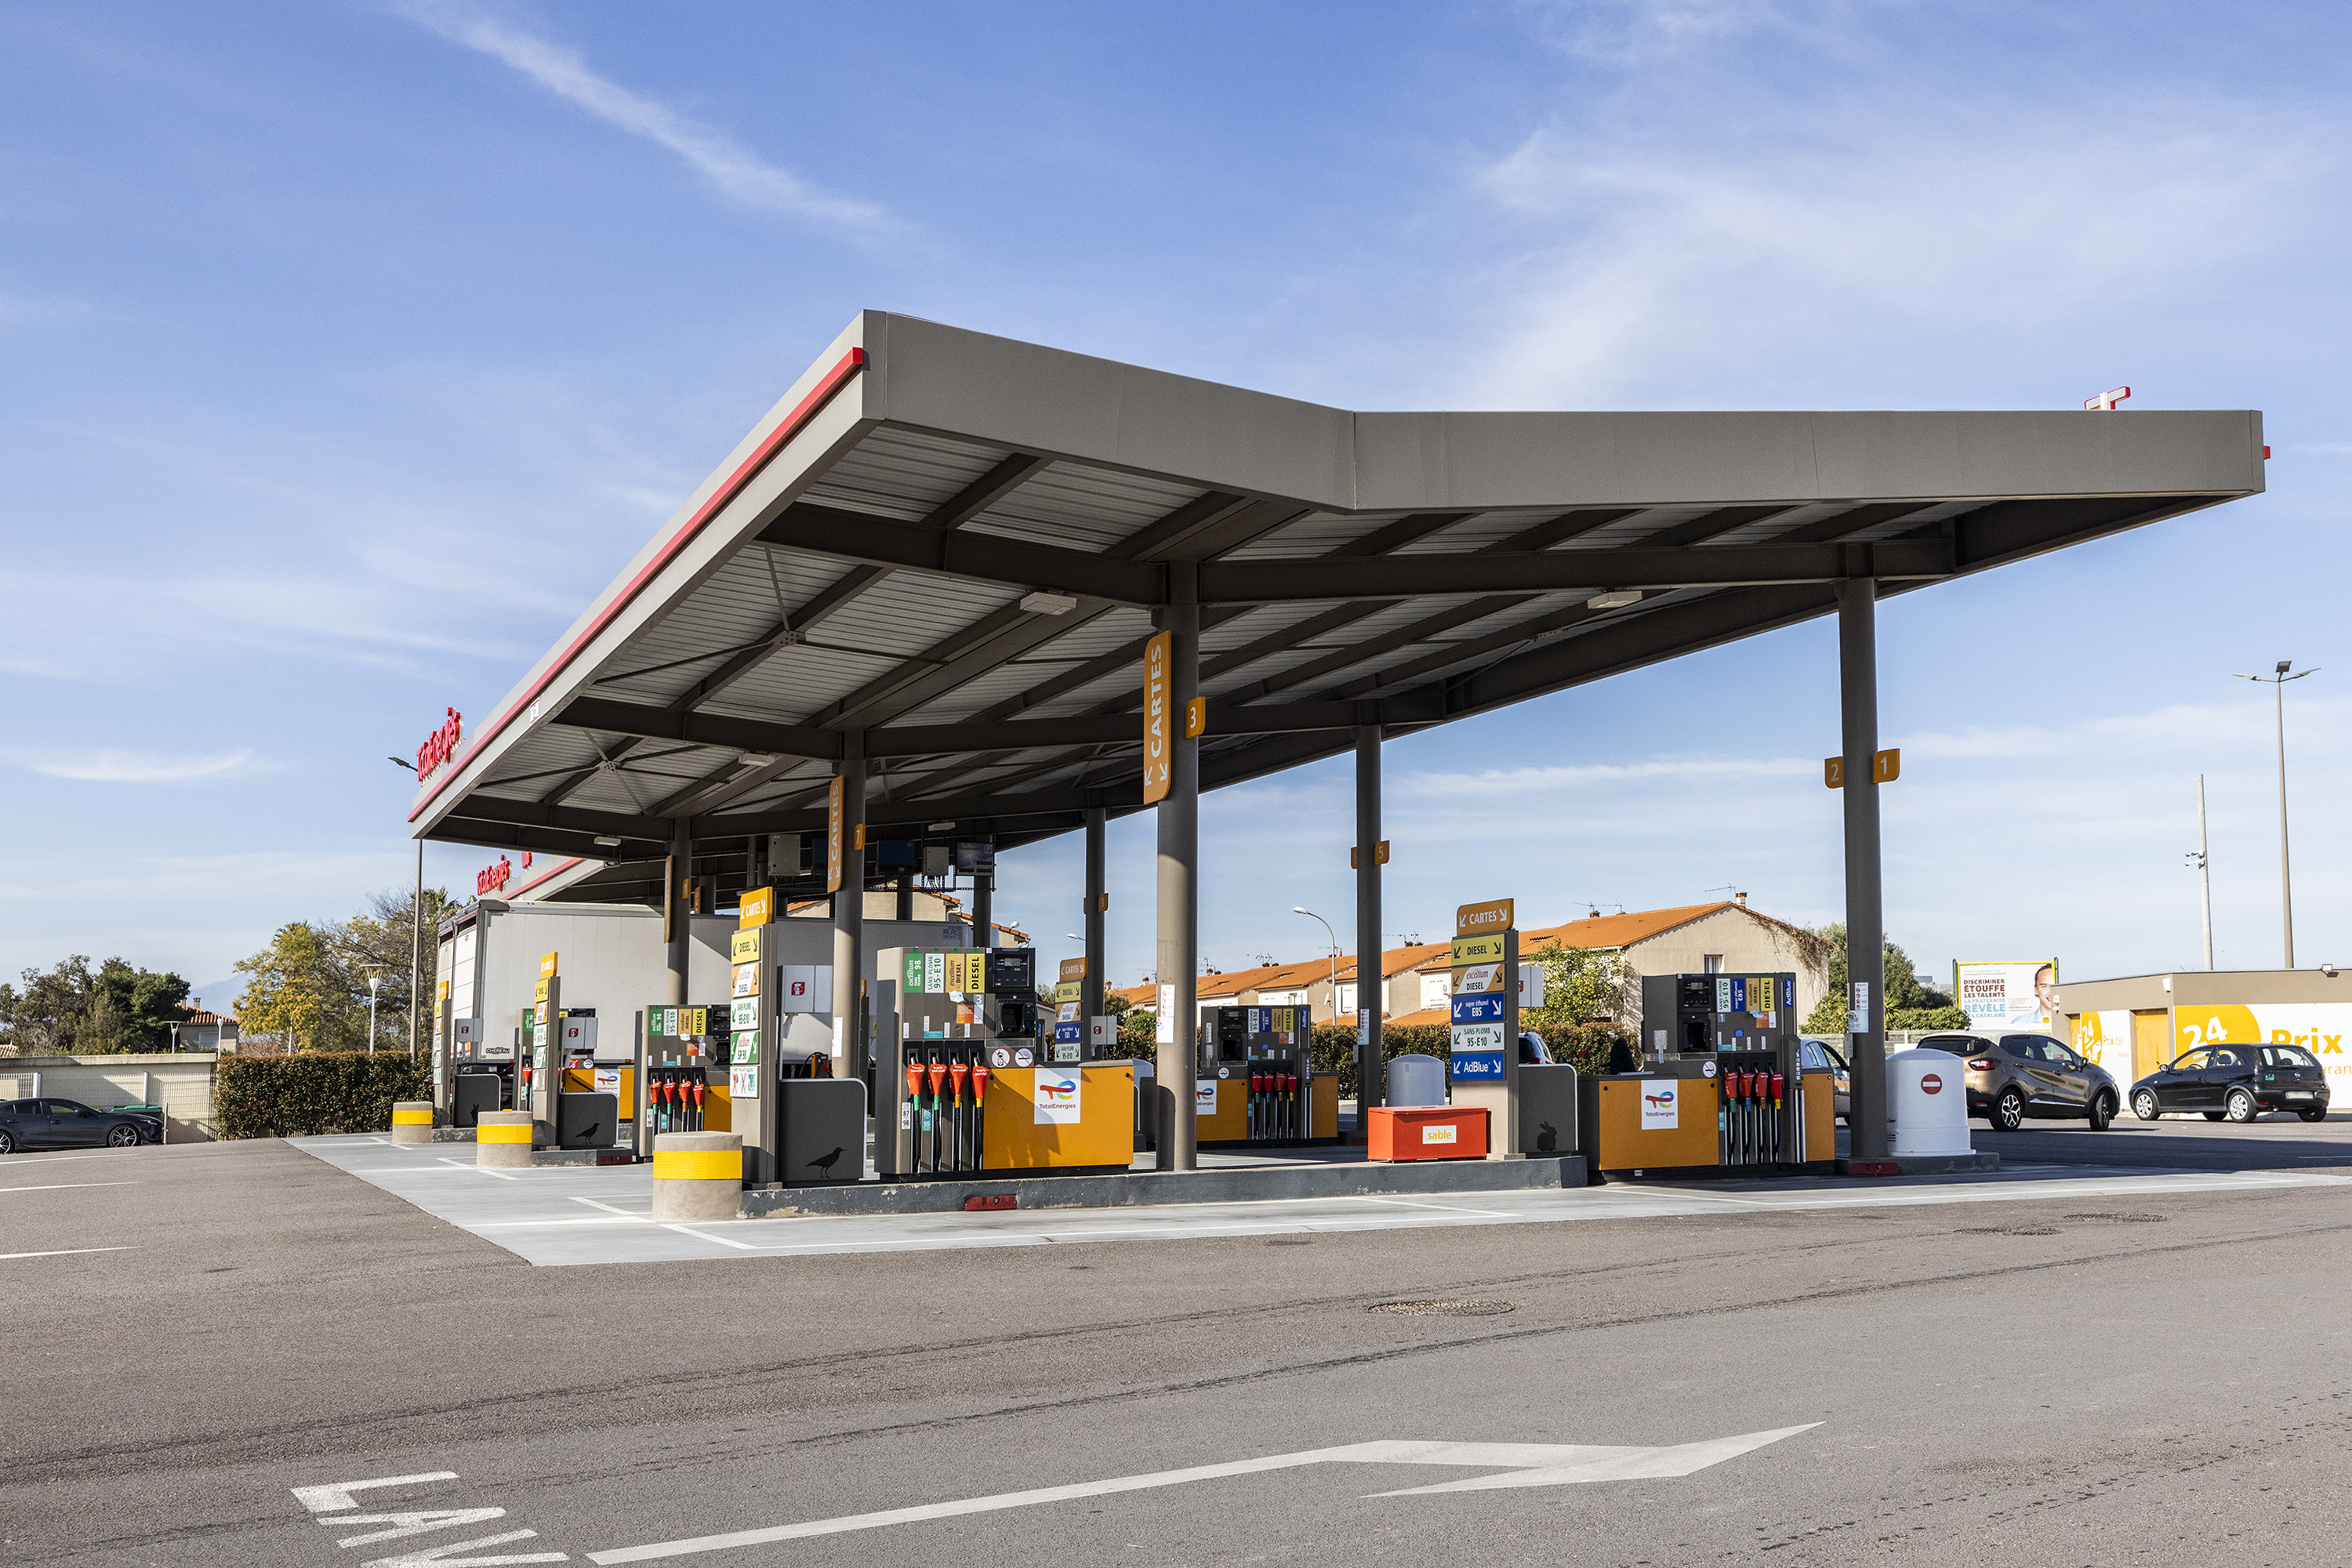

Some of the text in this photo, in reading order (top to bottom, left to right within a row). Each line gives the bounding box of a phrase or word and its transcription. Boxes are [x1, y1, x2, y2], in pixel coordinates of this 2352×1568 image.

[1151, 644, 1162, 758] CARTES
[1189, 706, 1196, 728] 3
[1880, 757, 1887, 775] 1
[1831, 763, 1839, 782] 2
[1378, 846, 1384, 859] 5
[746, 901, 760, 917] CARTES
[1469, 910, 1497, 925] CARTES
[1467, 945, 1487, 956] DIESEL
[914, 960, 921, 970] 98
[1065, 964, 1079, 975] CARTES
[1466, 969, 1489, 980] excellium
[1466, 982, 1483, 990] DIESEL
[976, 994, 982, 1004] 3
[1472, 1007, 1483, 1017] E85
[1965, 1003, 2005, 1013] RÉVÈLE
[2183, 1016, 2228, 1051] 24
[2103, 1035, 2114, 1046] Prix
[2271, 1027, 2343, 1054] Prix
[1463, 1061, 1489, 1073] AdBlue
[1428, 1130, 1452, 1140] sable
